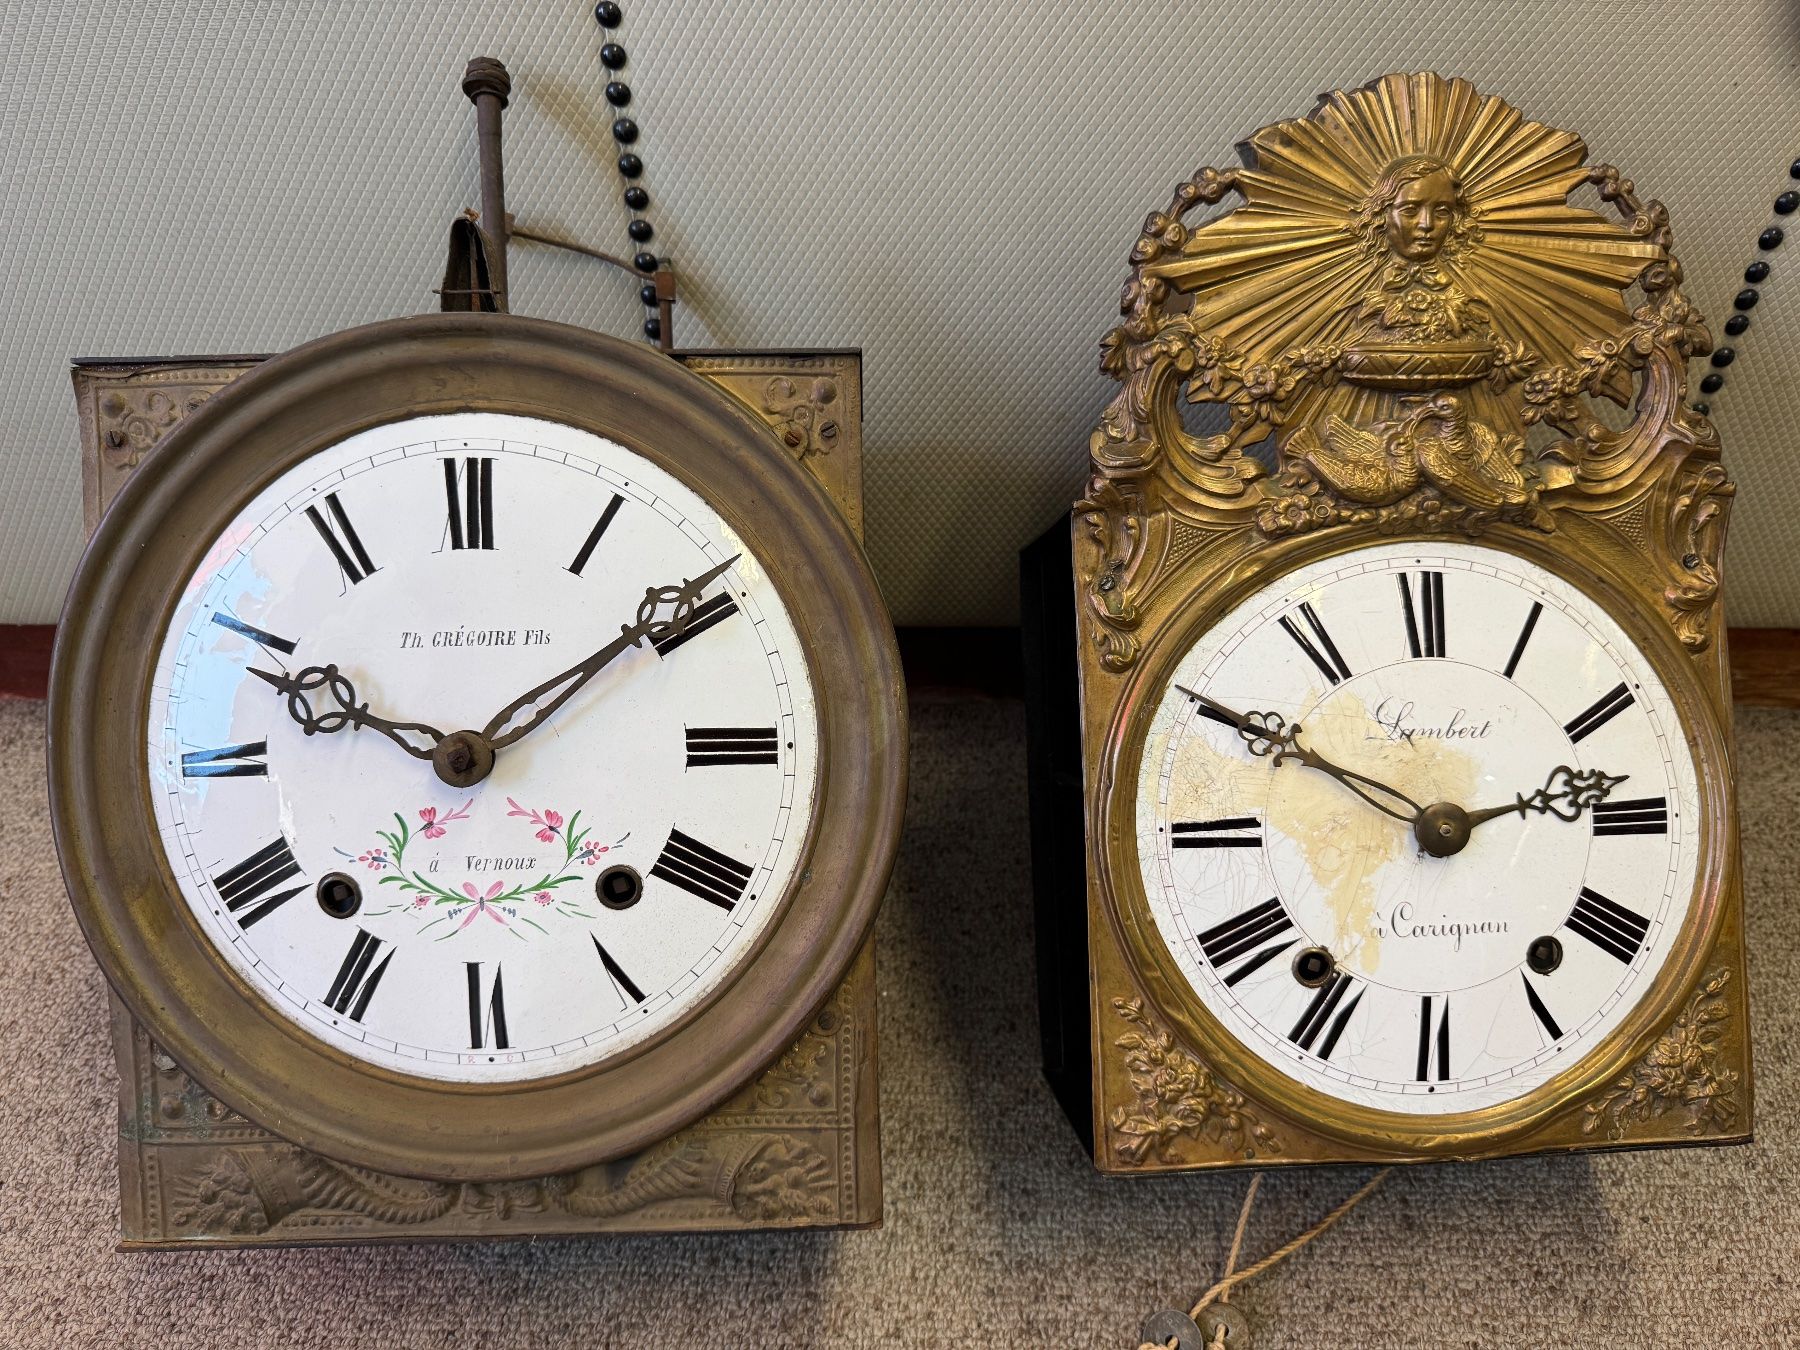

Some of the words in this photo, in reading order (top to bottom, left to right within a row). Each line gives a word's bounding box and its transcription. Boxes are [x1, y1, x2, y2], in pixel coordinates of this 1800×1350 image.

[301, 491, 383, 597] XI
[433, 457, 497, 553] XII
[563, 492, 629, 577] I
[399, 631, 424, 649] Th.
[432, 624, 517, 648] GRÉGOIRE
[522, 629, 551, 646] Fils
[651, 586, 742, 661] II
[1278, 601, 1353, 698] XI
[1395, 571, 1447, 658] XII
[1502, 601, 1544, 679] I
[685, 724, 779, 773] III
[1365, 695, 1491, 752] Lambert
[1562, 681, 1637, 745] II
[181, 735, 269, 779] IX
[1171, 814, 1263, 850] IX
[1591, 797, 1668, 836] III
[211, 829, 314, 930] VIII
[465, 855, 537, 872] Vernoux
[649, 823, 757, 914] IIII
[1196, 896, 1302, 988] VIII
[1391, 901, 1508, 952] Carignan
[1564, 886, 1652, 966] IIII
[320, 926, 397, 1023] VII
[462, 961, 511, 1049] VI
[590, 930, 649, 1011] V
[1520, 970, 1564, 1050] V
[1287, 972, 1369, 1061] VII
[1416, 994, 1450, 1081] VI
